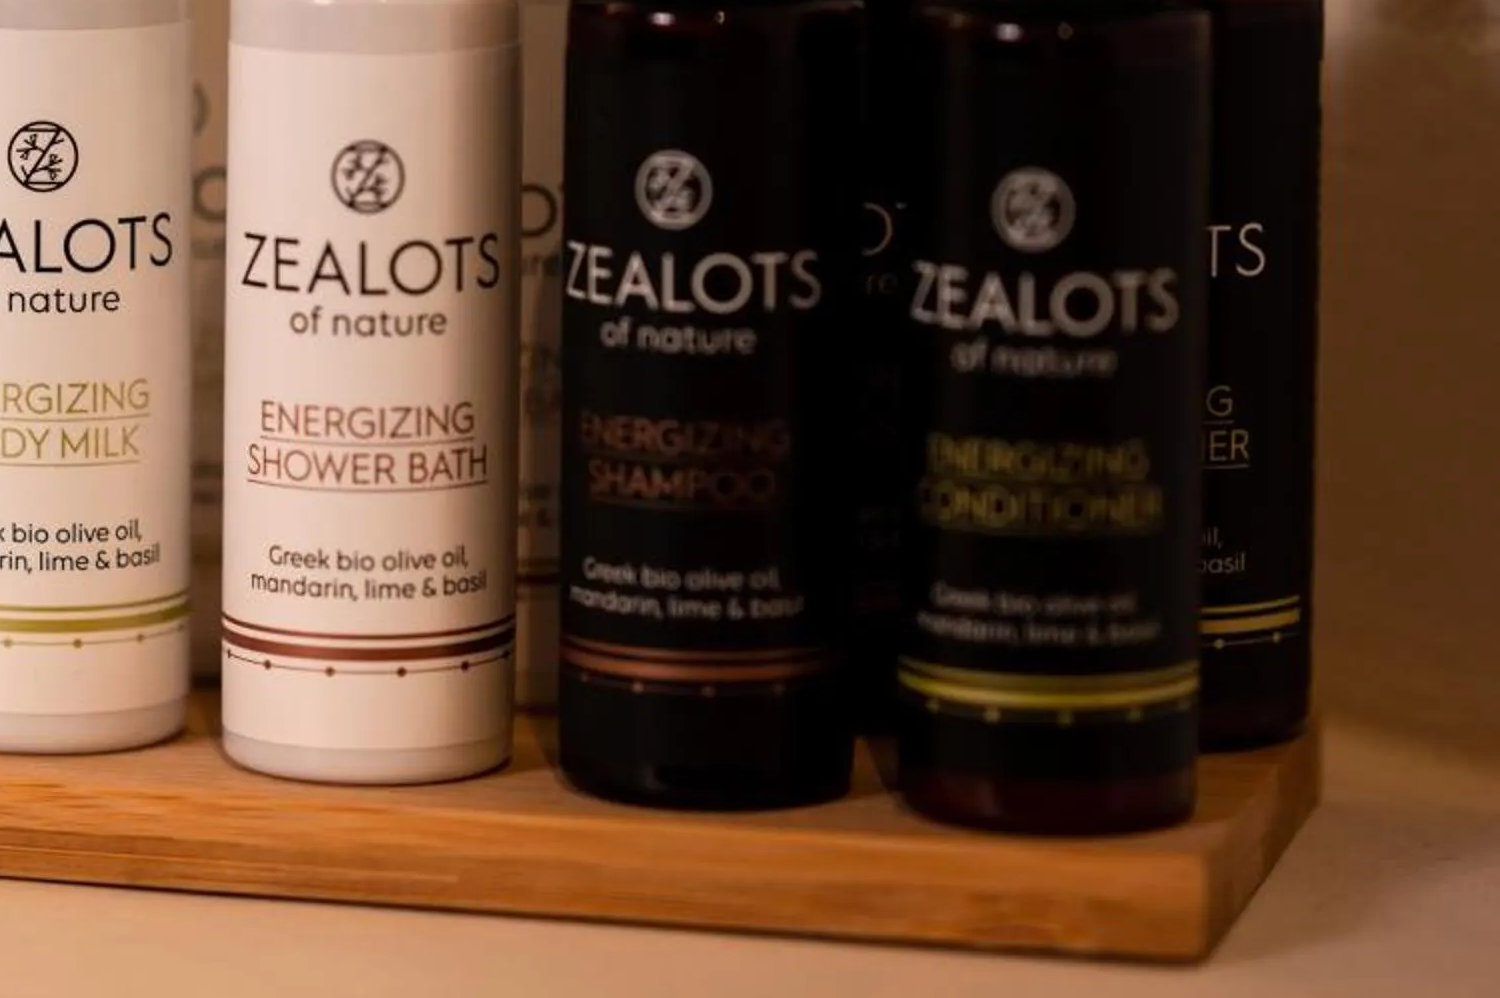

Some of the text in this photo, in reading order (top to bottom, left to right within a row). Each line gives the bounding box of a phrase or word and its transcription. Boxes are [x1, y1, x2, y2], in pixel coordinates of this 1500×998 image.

[242, 232, 500, 296] ZEALOTS
[566, 240, 822, 313] ZEALOTS
[8, 288, 120, 313] nature
[911, 260, 1180, 336] ZEALOTS
[290, 305, 447, 337] of nature
[600, 316, 757, 353] of nature
[261, 400, 475, 439] ENERGIZING
[61, 424, 139, 459] MILK
[248, 444, 488, 485] SHOWER BATH
[588, 459, 776, 500] SHAMPOO
[11, 523, 49, 544] bio
[55, 523, 109, 544] olive
[115, 518, 142, 542] oil,
[39, 552, 89, 571] lime
[95, 550, 110, 570] &
[116, 543, 161, 568] basil
[269, 544, 469, 571] Greek bio olive oil,
[251, 570, 488, 602] mandarin, lime & basil
